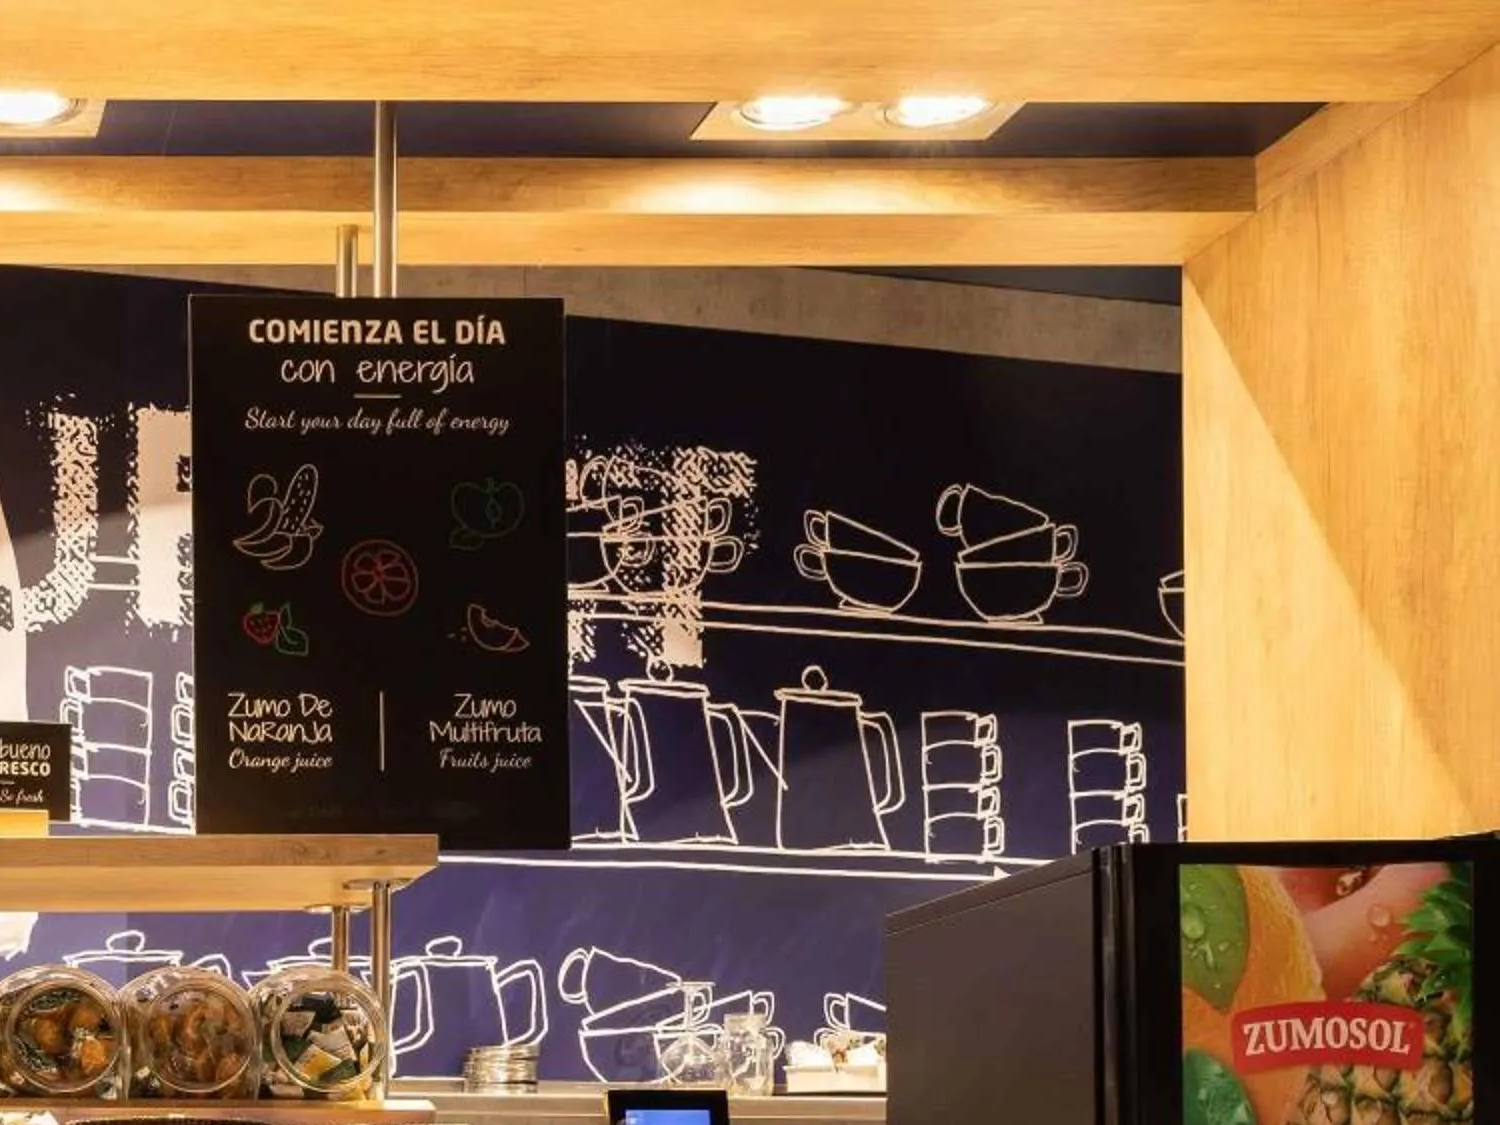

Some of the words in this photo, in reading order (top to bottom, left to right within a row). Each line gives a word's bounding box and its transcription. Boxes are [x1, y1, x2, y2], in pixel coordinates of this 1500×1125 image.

[249, 318, 403, 345] COMIENZA
[413, 319, 446, 345] EL
[456, 314, 506, 345] DÍA
[280, 357, 335, 383] con
[356, 353, 475, 394] energía
[244, 406, 296, 430] Start
[300, 415, 341, 436] your
[347, 407, 382, 436] day
[387, 407, 423, 436] full
[425, 407, 450, 436] of
[450, 415, 512, 436] energy
[297, 692, 333, 718] De
[0, 738, 50, 759] bueno
[229, 747, 291, 773] Orange
[290, 751, 333, 773] juice
[490, 752, 533, 773] juice
[1242, 1015, 1411, 1056] ZUMOSOL
